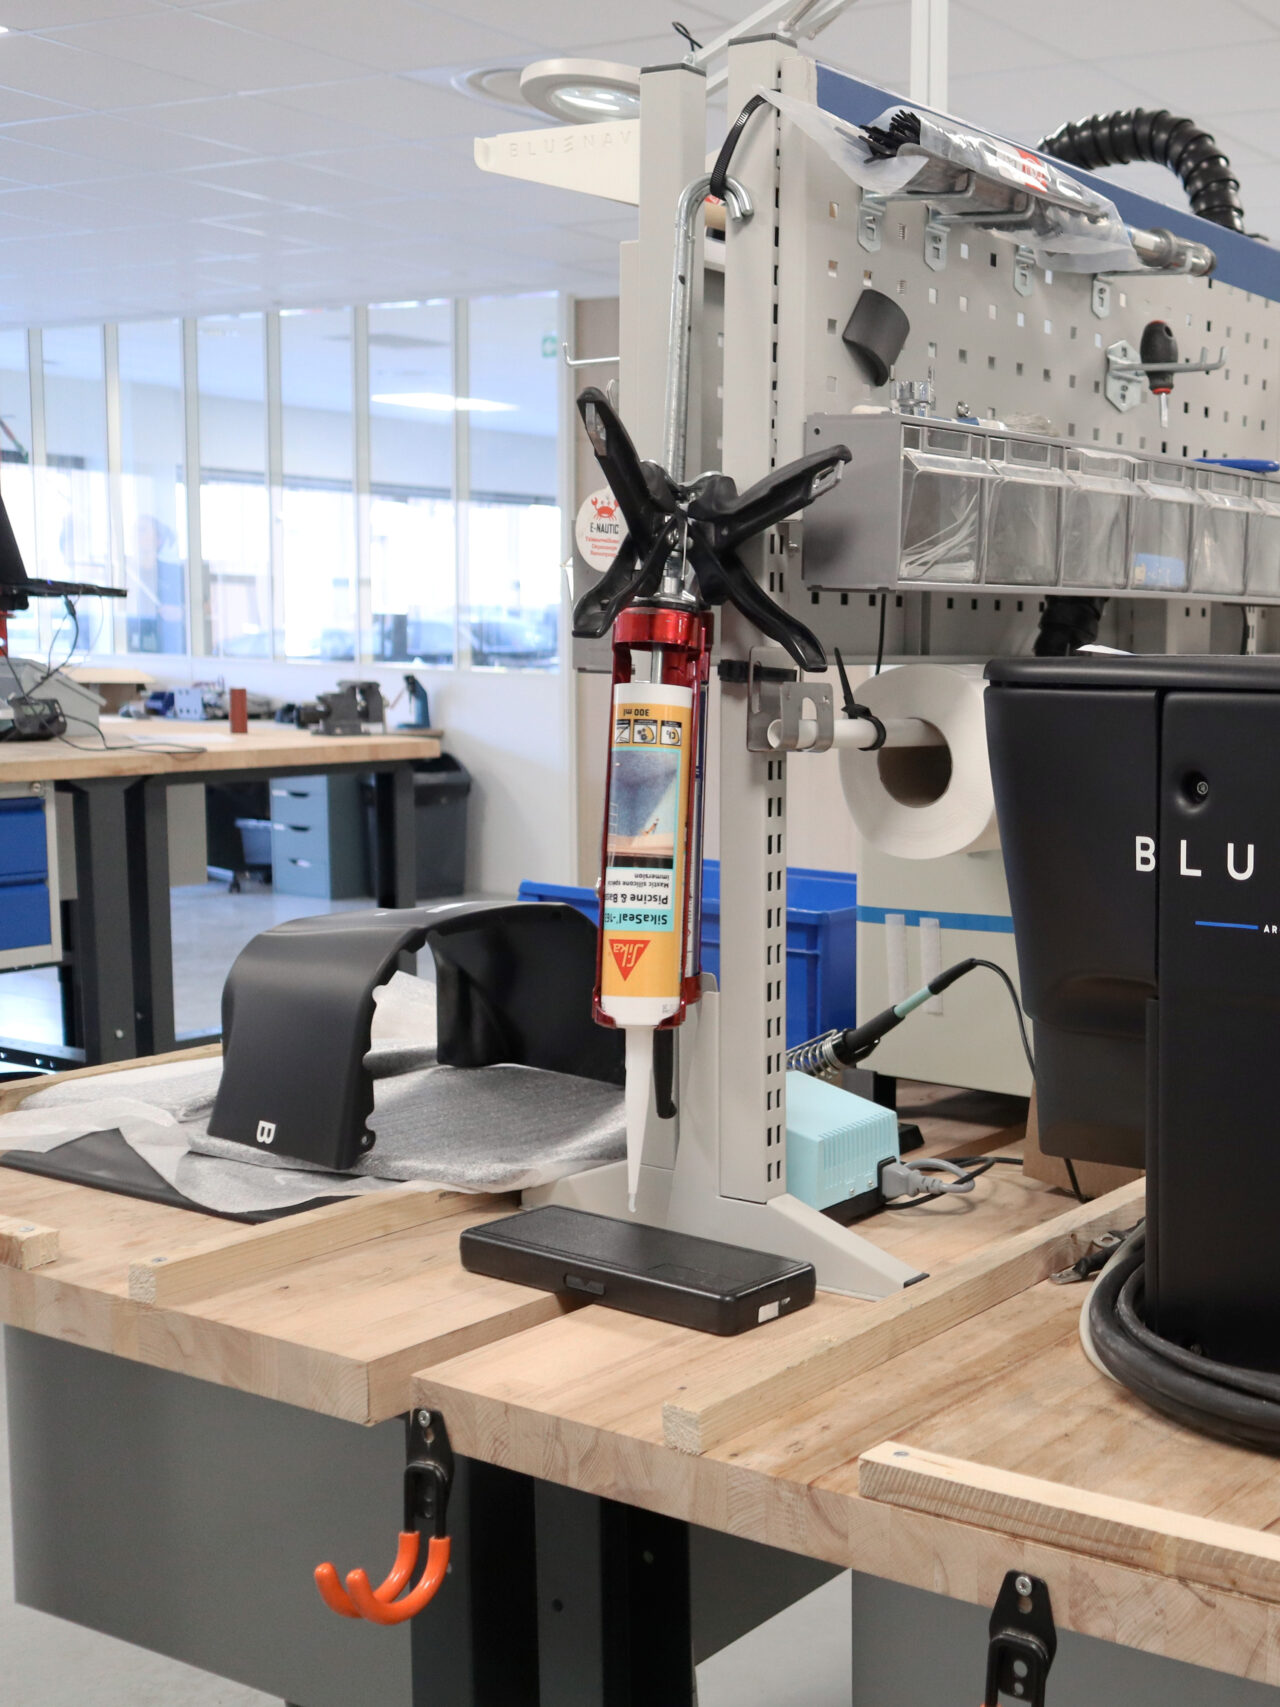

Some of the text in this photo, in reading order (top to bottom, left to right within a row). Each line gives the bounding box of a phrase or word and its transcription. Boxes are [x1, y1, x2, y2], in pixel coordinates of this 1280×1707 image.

[509, 130, 632, 158] BLUENAV
[590, 522, 619, 535] E-NAUTIC
[634, 709, 650, 717] 300
[634, 873, 670, 881] immersion
[622, 880, 647, 888] silicone
[621, 893, 627, 903] &
[630, 893, 668, 905] Piscine
[613, 943, 645, 968] Sika
[256, 1120, 276, 1144] B
